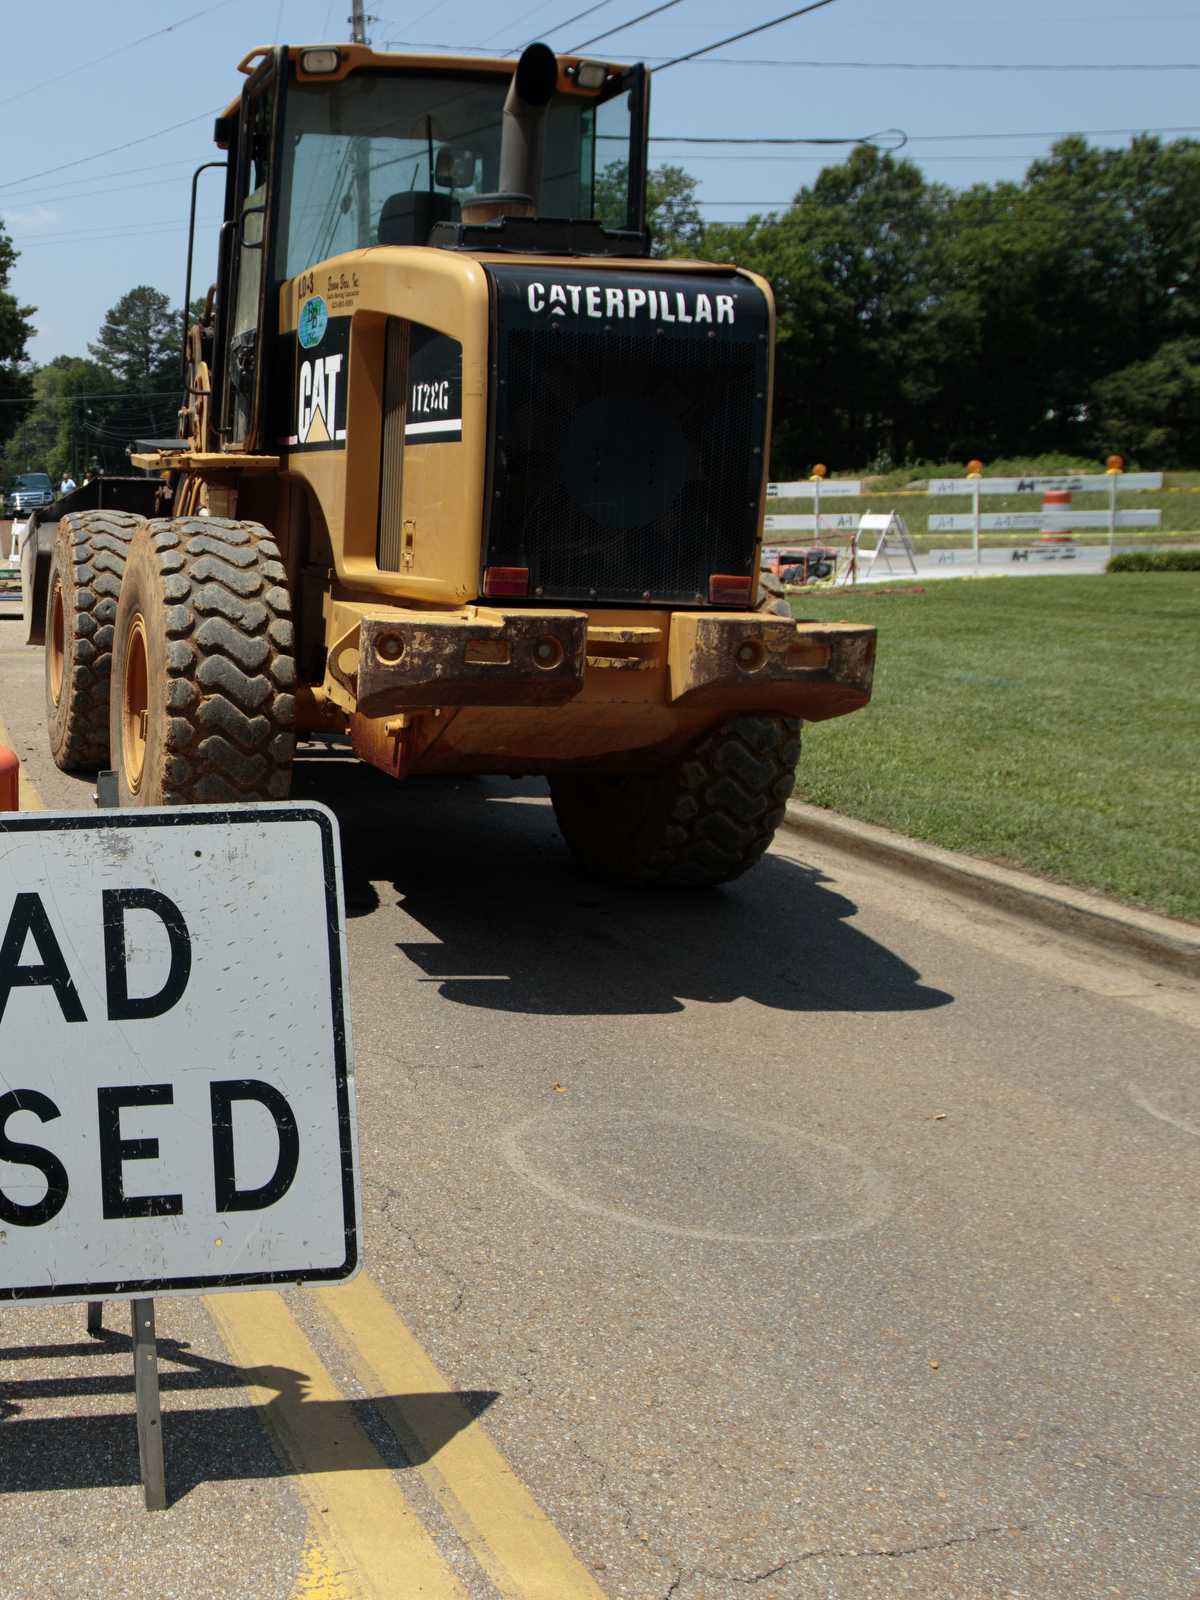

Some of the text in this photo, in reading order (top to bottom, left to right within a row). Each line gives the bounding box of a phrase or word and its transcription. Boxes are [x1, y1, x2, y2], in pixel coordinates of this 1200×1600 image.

[299, 271, 314, 299] LD-3
[528, 281, 735, 325] CATERPILLAR
[299, 353, 341, 444] CAT
[837, 516, 853, 527] A-1
